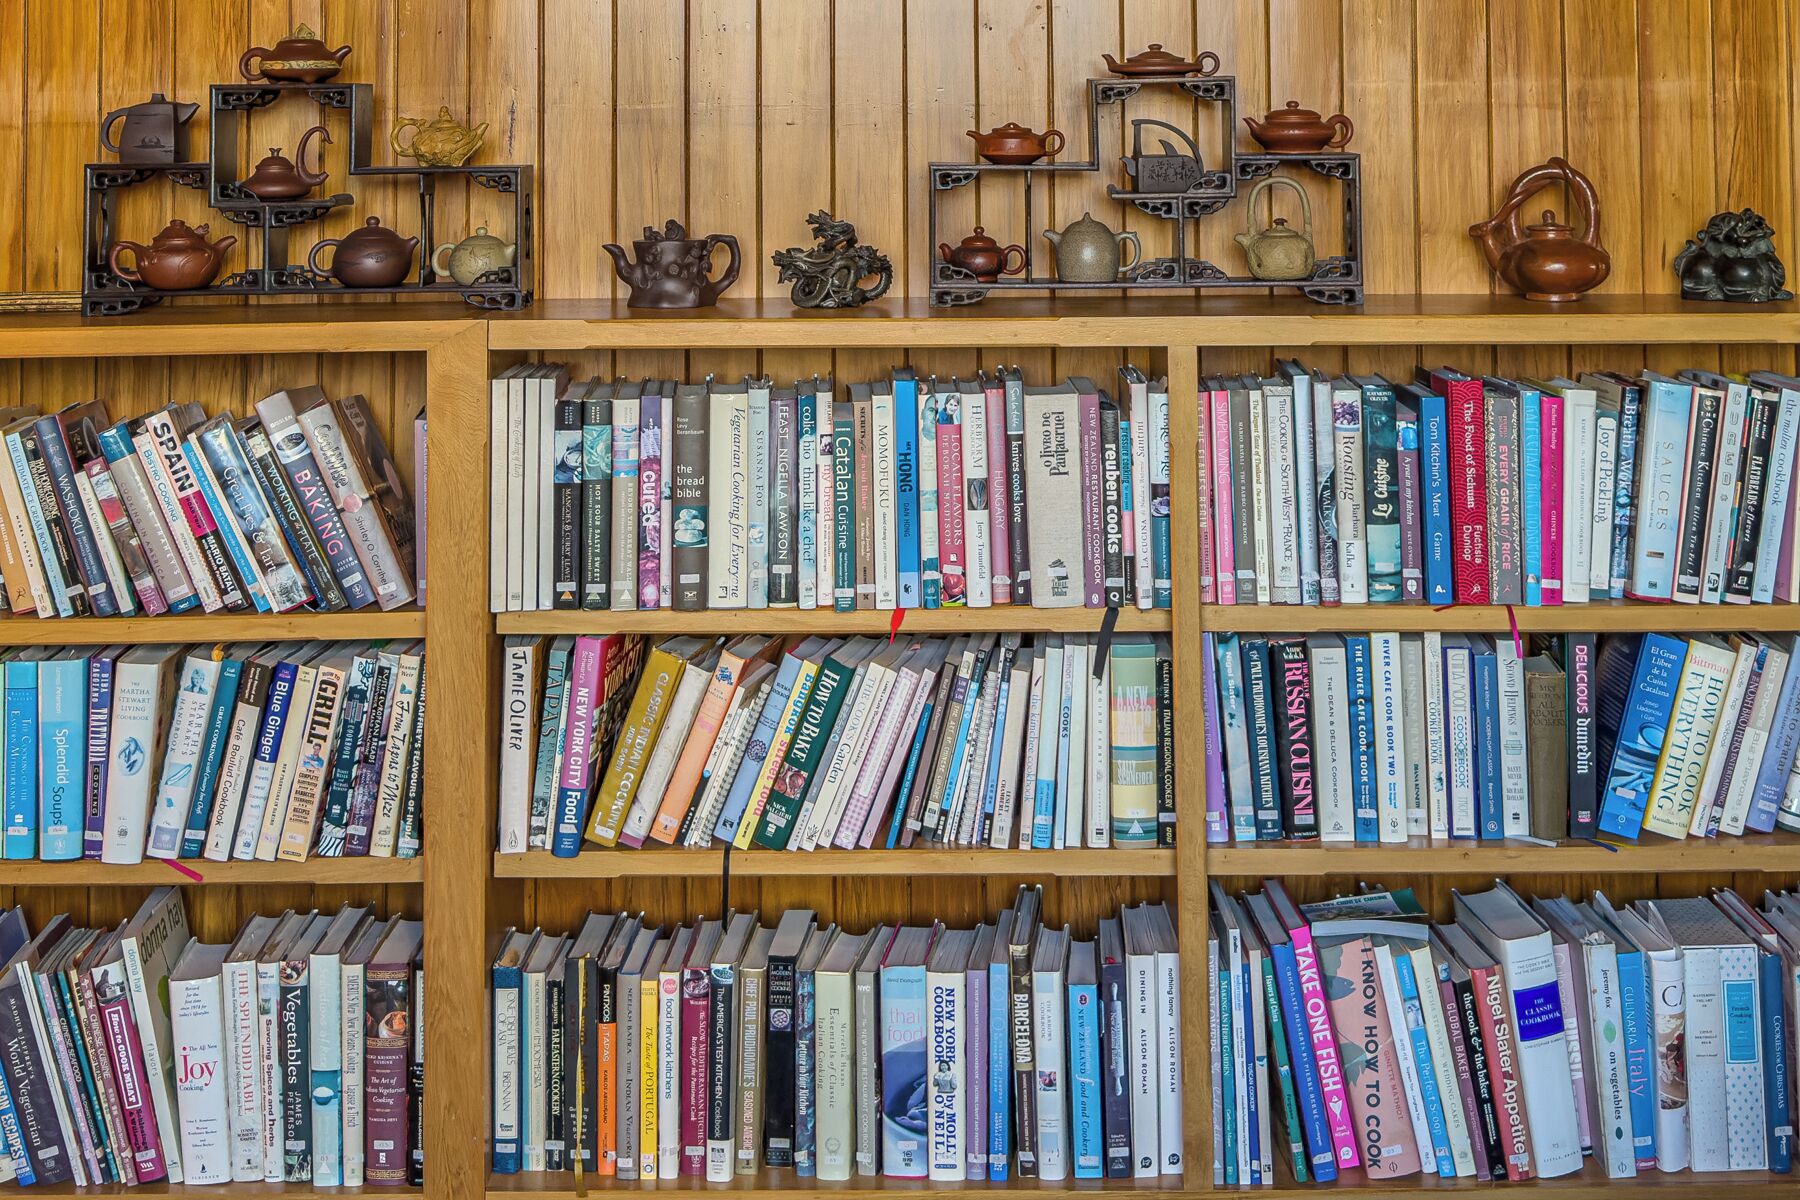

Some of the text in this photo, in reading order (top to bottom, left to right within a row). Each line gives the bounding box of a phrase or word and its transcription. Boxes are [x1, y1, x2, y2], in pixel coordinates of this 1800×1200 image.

[152, 420, 194, 493] SPAIN
[677, 465, 692, 474] the
[677, 476, 704, 485] bread
[777, 406, 788, 559] FEAST NIGELLA LAWSON
[878, 425, 888, 508] MOMOFUKU
[1011, 440, 1023, 522] knives cooks love
[1341, 435, 1354, 501] Roasting
[1463, 401, 1476, 508] The Food of Sichuan
[1594, 425, 1614, 523] Joy of Pickling
[8, 438, 49, 554] THE ULTIMATE ICE CREAM BOOK
[56, 473, 85, 536] WASHOKU
[142, 449, 179, 523] BISTRO COOKING
[294, 467, 343, 557] BAKING
[314, 474, 345, 539] PROFESSIONAL
[641, 470, 656, 526] cured
[677, 489, 701, 498] bible
[726, 407, 747, 597] Vegetarian Cooking for Everyone
[835, 436, 850, 548] Catalan Cuisine
[992, 469, 1006, 530] HUNGARY
[1088, 407, 1101, 584] NEW ZEALAND RESTAURANT COOKBOOK
[1104, 443, 1119, 553] reuben cooks
[1429, 416, 1442, 560] Tom Kitchin's Meat Game
[1499, 445, 1511, 569] EVERY GRAIN of RICE
[1655, 441, 1672, 530] SAUCES
[1462, 525, 1472, 560] Dunlop
[1473, 525, 1482, 563] Fuchsia
[1382, 639, 1390, 666] RIVER
[1383, 670, 1391, 692] CAFE
[1647, 675, 1667, 688] Cuina
[1651, 646, 1678, 660] El Gran
[1651, 666, 1667, 677] de la
[1652, 657, 1672, 669] Llibre
[305, 678, 340, 746] GRILL
[508, 650, 527, 750] JAMIE OLIVER
[540, 660, 565, 738] TAPAS
[791, 668, 840, 763] HOW TO BAKE
[1385, 695, 1393, 722] COOK
[1575, 645, 1592, 773] DELICIOUS dunedin
[1640, 683, 1670, 698] Catalana
[87, 706, 108, 762] TRATTORIA
[259, 681, 288, 761] Blue Ginger
[568, 686, 588, 785] NEW YORK CITY
[1282, 662, 1314, 816] RUSSIAN CUISIN
[1386, 725, 1394, 751] BOOK
[1656, 670, 1706, 812] EVERYTHING
[1676, 677, 1723, 816] HOW TO COOK
[53, 729, 70, 783] Splendid
[215, 718, 245, 826] Café Boulud Cookbook
[1387, 755, 1395, 775] TWO
[49, 785, 64, 825] Soups
[563, 790, 581, 824] Food
[889, 1007, 922, 1025] thai
[1140, 1004, 1146, 1014] IN
[1166, 967, 1175, 1016] nothing fancy
[1294, 942, 1341, 1091] TAKE ONE FISH
[1361, 960, 1376, 1018] KNOW
[1462, 992, 1473, 1009] the
[1525, 1004, 1553, 1015] CLASSIC
[1534, 997, 1544, 1005] THE
[1600, 968, 1612, 1009] jeremy fox
[1623, 986, 1638, 1044] CULINARIA
[263, 1018, 273, 1060] Savoring
[282, 988, 301, 1083] Vegetables
[887, 1026, 924, 1042] food
[934, 986, 943, 1063] COOKBOOK
[945, 988, 955, 1064] NEW YORK
[1013, 993, 1030, 1062] BARCELONA
[1445, 1002, 1469, 1079] GLOBAL BAKER
[1465, 1009, 1478, 1035] cook
[1470, 1036, 1482, 1051] &
[1520, 1011, 1560, 1026] COOKBOOK
[110, 1012, 136, 1103] How to COOK MEAT
[664, 998, 673, 1099] food network kitchens
[1364, 1025, 1378, 1073] HOW
[1473, 1052, 1485, 1069] the
[1484, 974, 1528, 1154] Nigel Slater Appetite
[1628, 1048, 1647, 1097] Italy
[265, 1063, 274, 1095] Spices
[1366, 1080, 1380, 1107] TO
[1476, 1069, 1490, 1099] baker
[1608, 1051, 1623, 1119] on vegetables
[267, 1118, 277, 1146] herbs
[1366, 1110, 1381, 1169] COOK
